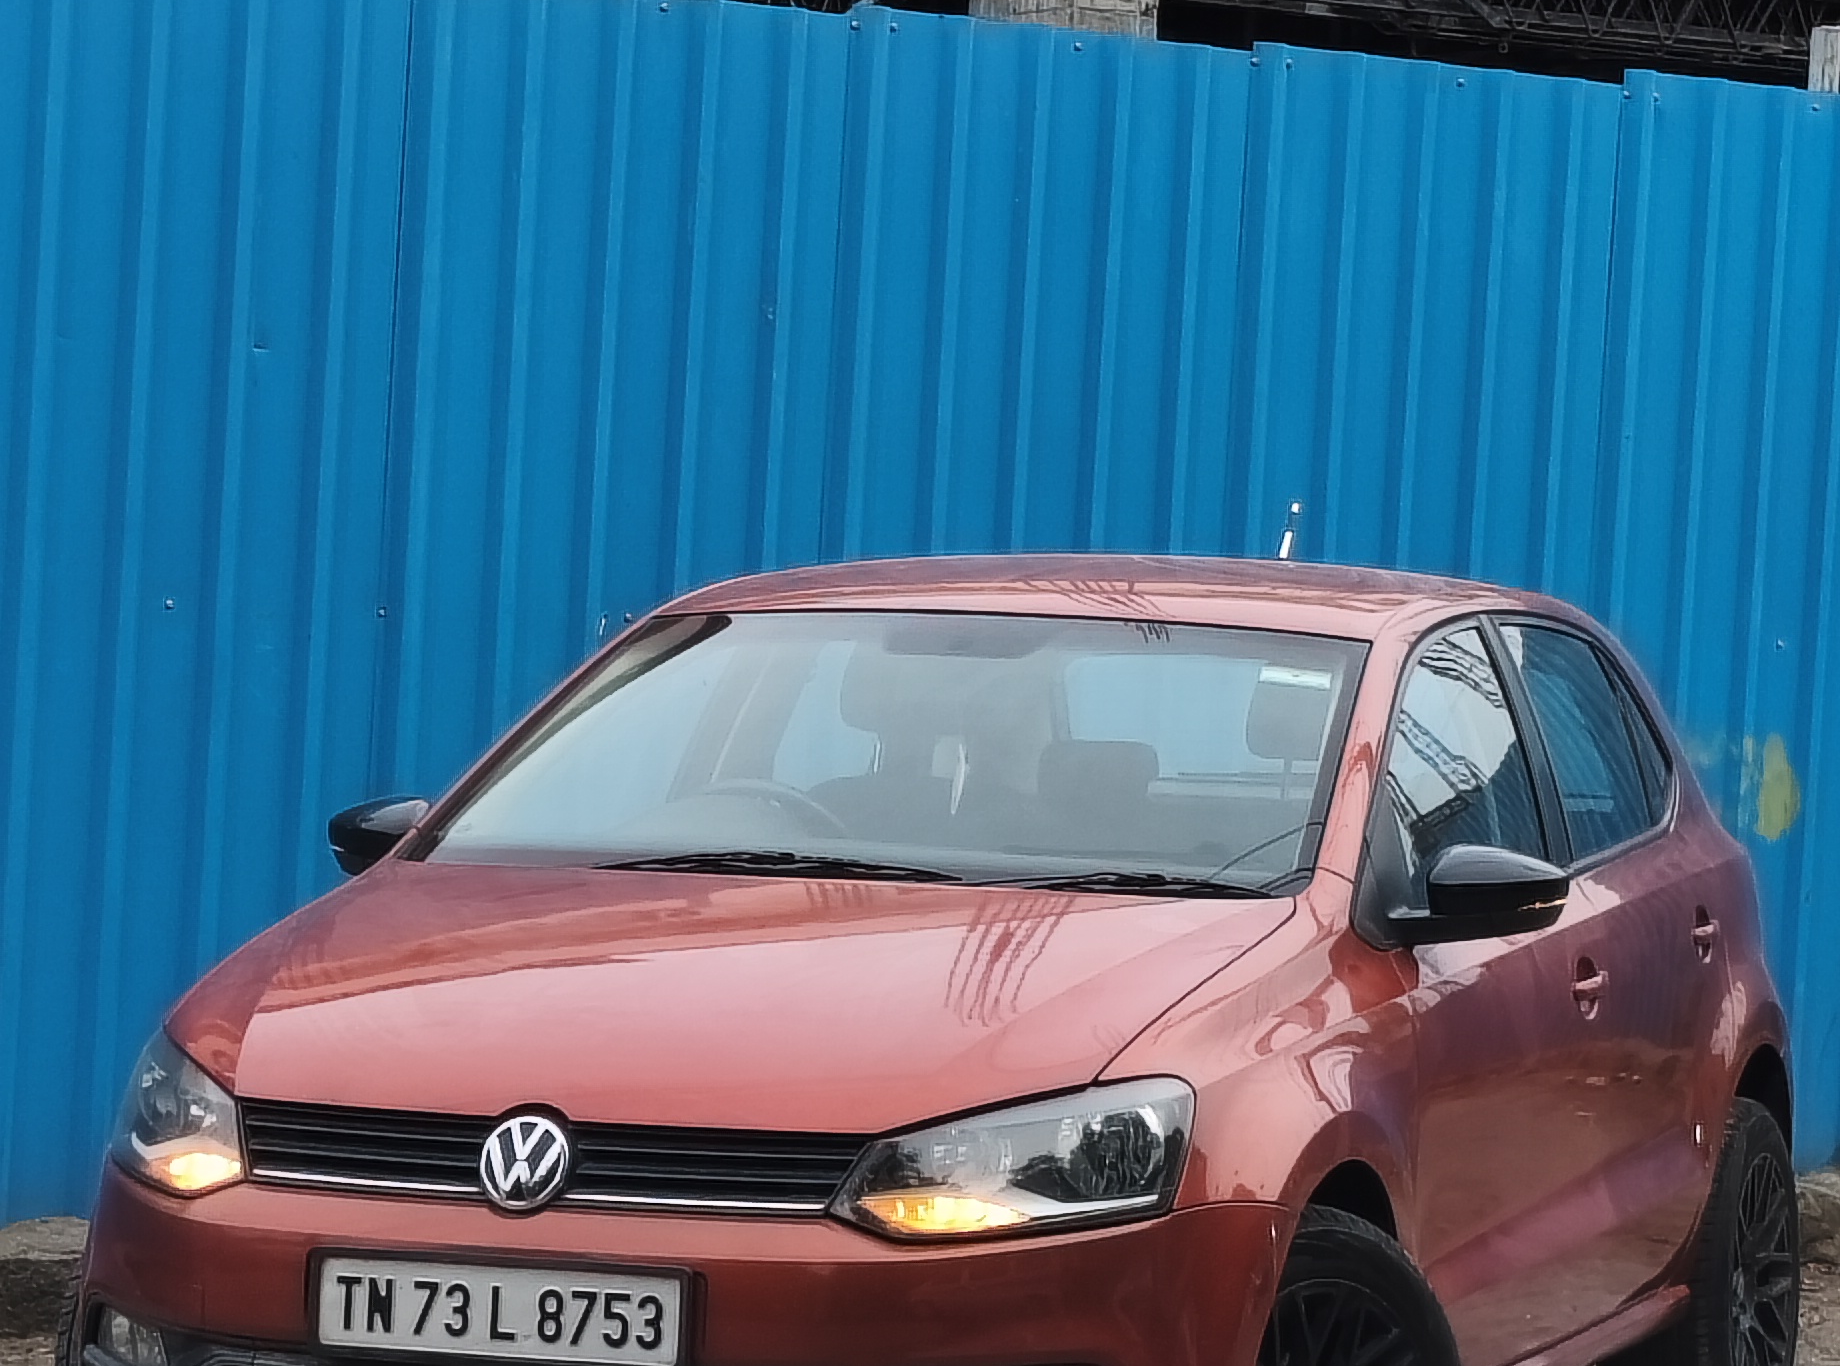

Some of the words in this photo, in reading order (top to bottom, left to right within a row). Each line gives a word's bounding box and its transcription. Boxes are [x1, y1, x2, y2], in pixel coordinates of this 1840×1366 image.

[487, 1121, 563, 1202] VW
[336, 1275, 394, 1334] TN
[412, 1281, 471, 1337] 73
[489, 1285, 516, 1341] L
[537, 1288, 663, 1350] 8753
